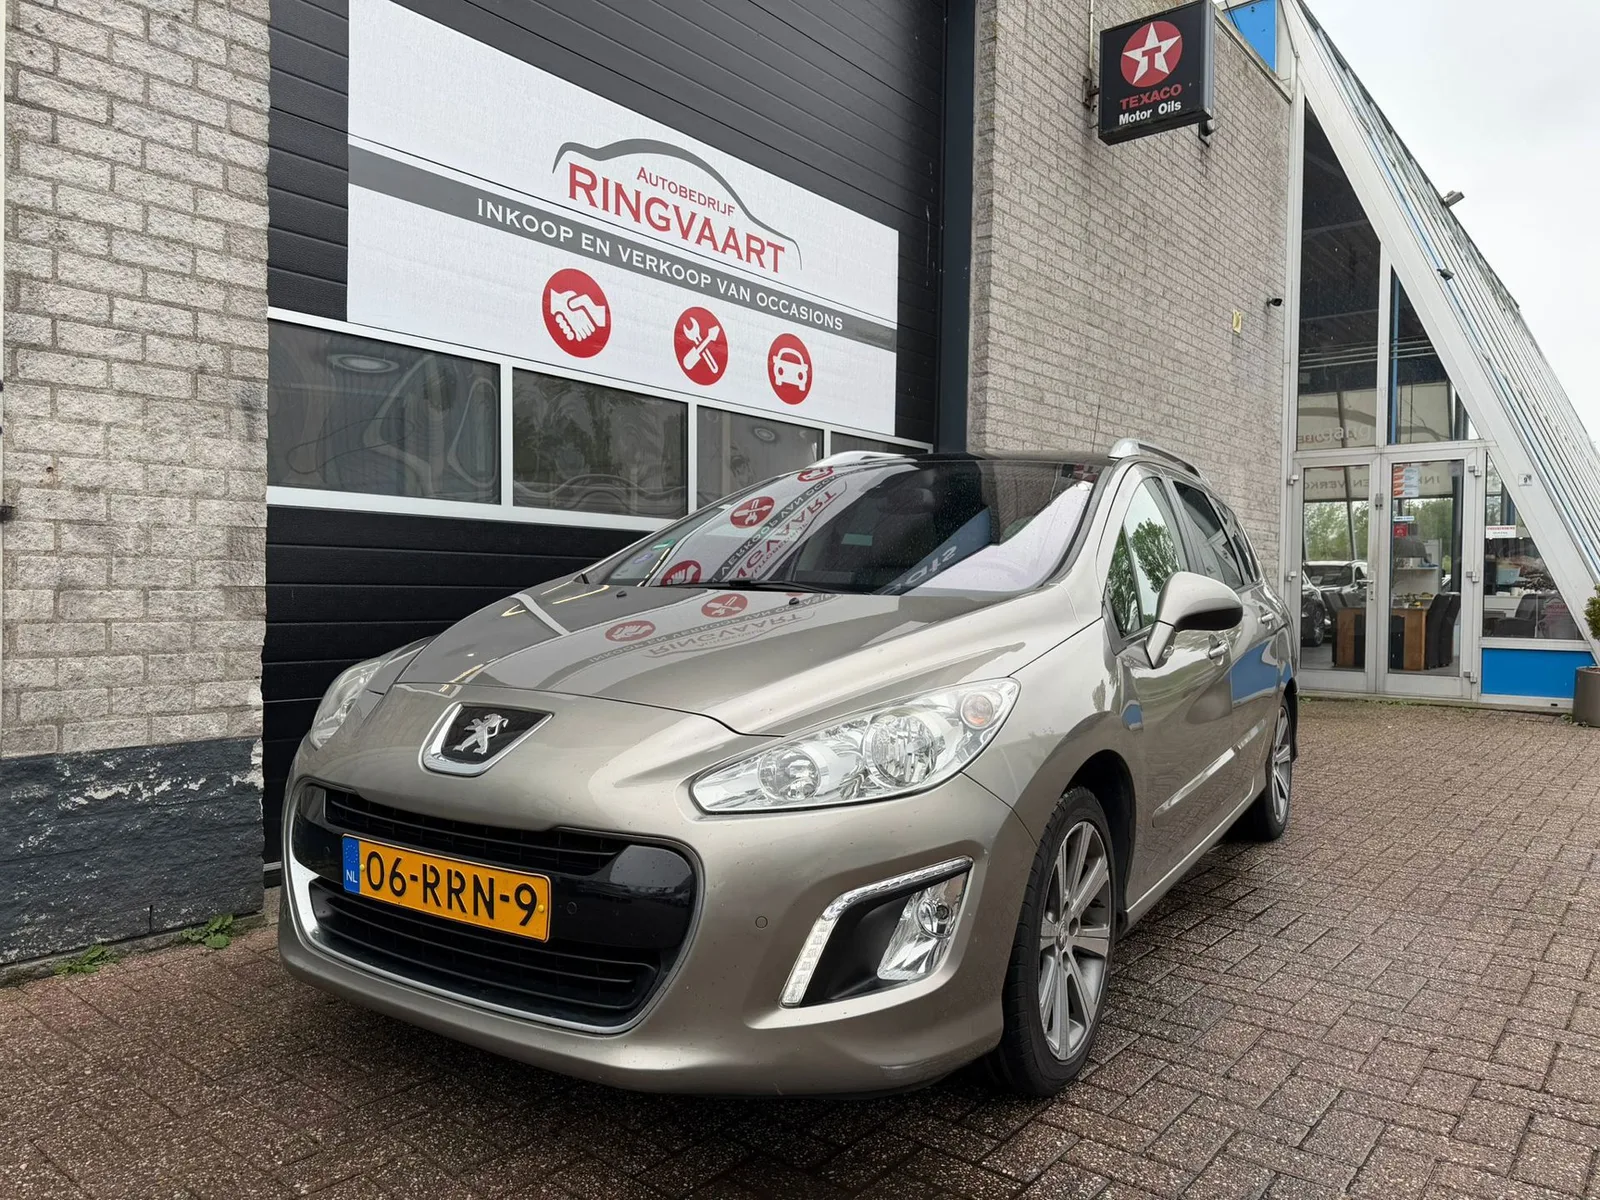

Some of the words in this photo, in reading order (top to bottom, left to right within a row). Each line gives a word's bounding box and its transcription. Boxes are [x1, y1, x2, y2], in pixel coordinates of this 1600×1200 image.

[1119, 108, 1152, 125] Motor
[1158, 100, 1181, 115] Oils
[1120, 84, 1182, 110] TEXACO
[568, 162, 785, 273] RINGVAART
[636, 167, 735, 216] AUTOBEDRIJF
[477, 198, 574, 242] INKOOP
[581, 234, 611, 257] EN
[618, 247, 712, 288] VERKOOP
[716, 277, 751, 302] VAN
[756, 292, 844, 331] OCCASIONS
[346, 869, 358, 883] NL
[366, 851, 538, 926] 06-RRN-9
